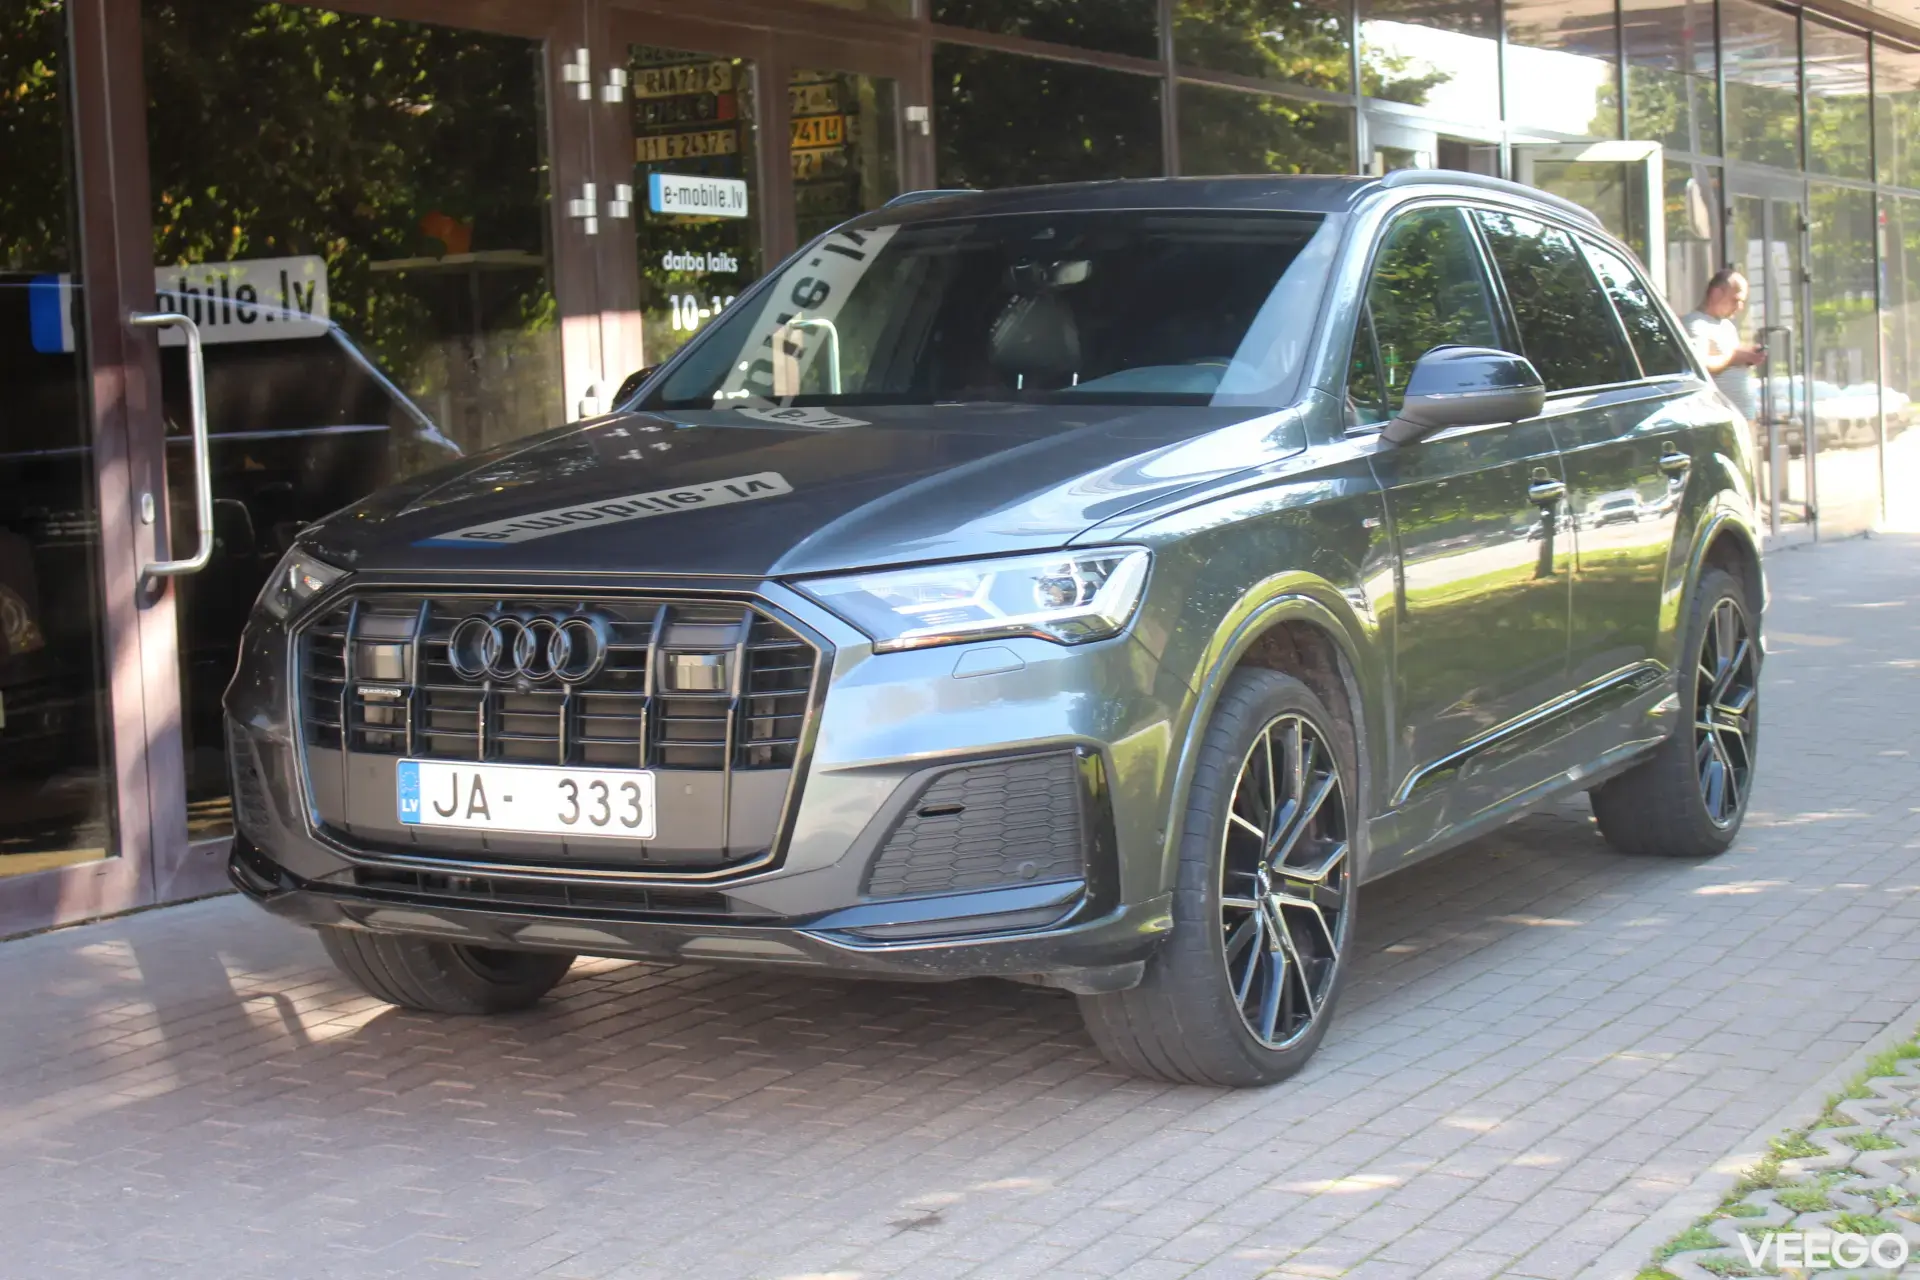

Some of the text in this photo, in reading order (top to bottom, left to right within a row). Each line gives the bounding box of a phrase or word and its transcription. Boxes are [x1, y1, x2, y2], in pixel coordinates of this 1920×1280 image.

[664, 184, 743, 209] e-mobile.lv
[662, 250, 738, 273] darba laiks
[669, 294, 736, 331] 10-1
[401, 799, 419, 813] LV
[558, 778, 643, 829] 333
